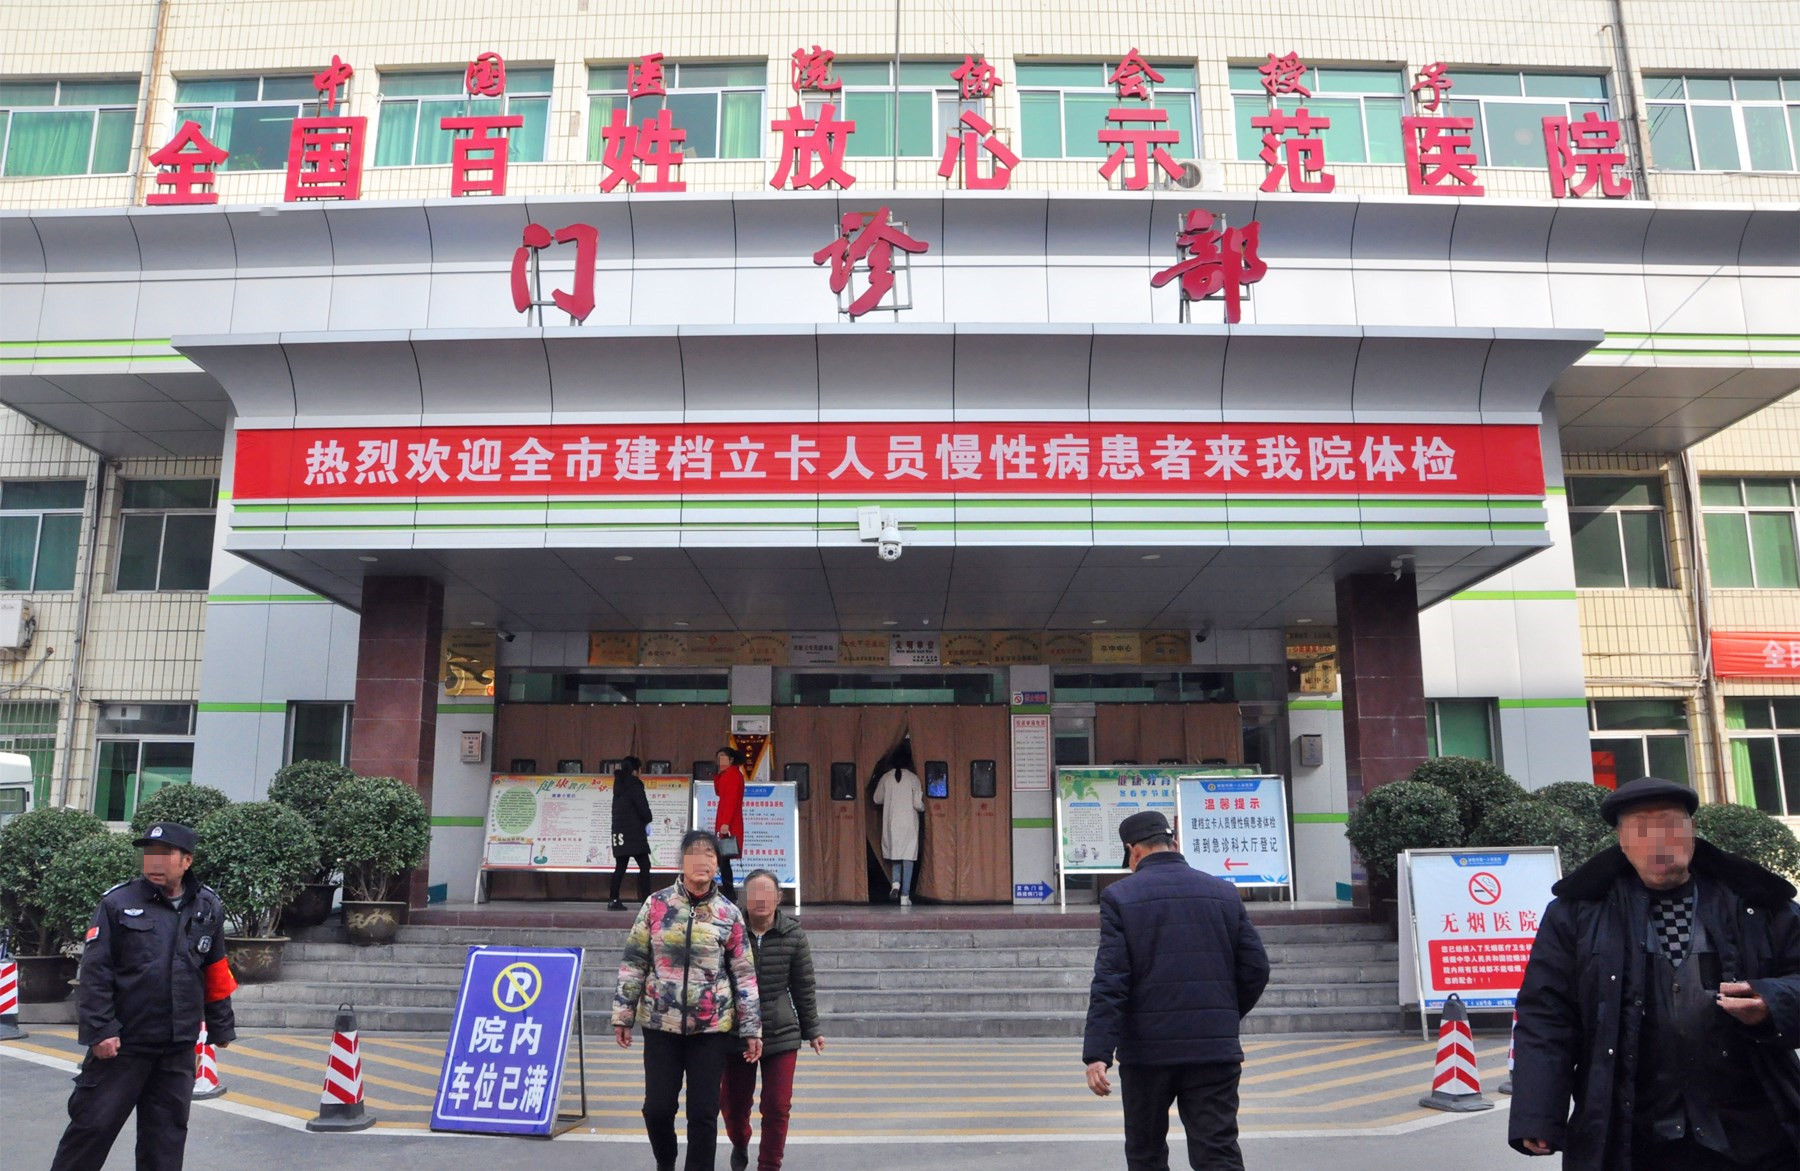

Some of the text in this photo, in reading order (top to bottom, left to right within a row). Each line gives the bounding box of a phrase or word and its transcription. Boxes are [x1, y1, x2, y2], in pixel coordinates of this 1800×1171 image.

[313, 45, 1453, 111] 中国医院协会授予
[146, 103, 1632, 207] 全国百姓放心示范医院
[511, 207, 1267, 323] 门诊部
[304, 434, 1458, 486] 热烈欢迎全市建档立卡人员慢性病患者来我院体检
[1118, 774, 1170, 786] 健康教育
[1204, 797, 1260, 810] 温馨提示
[1191, 817, 1276, 830] 建档立卡人员慢性病患者体检
[1192, 837, 1278, 853] 请到急诊科大厅登记
[1440, 910, 1539, 934] 无烟医院
[468, 1016, 543, 1055] 院内
[448, 1061, 549, 1114] 车位已满
